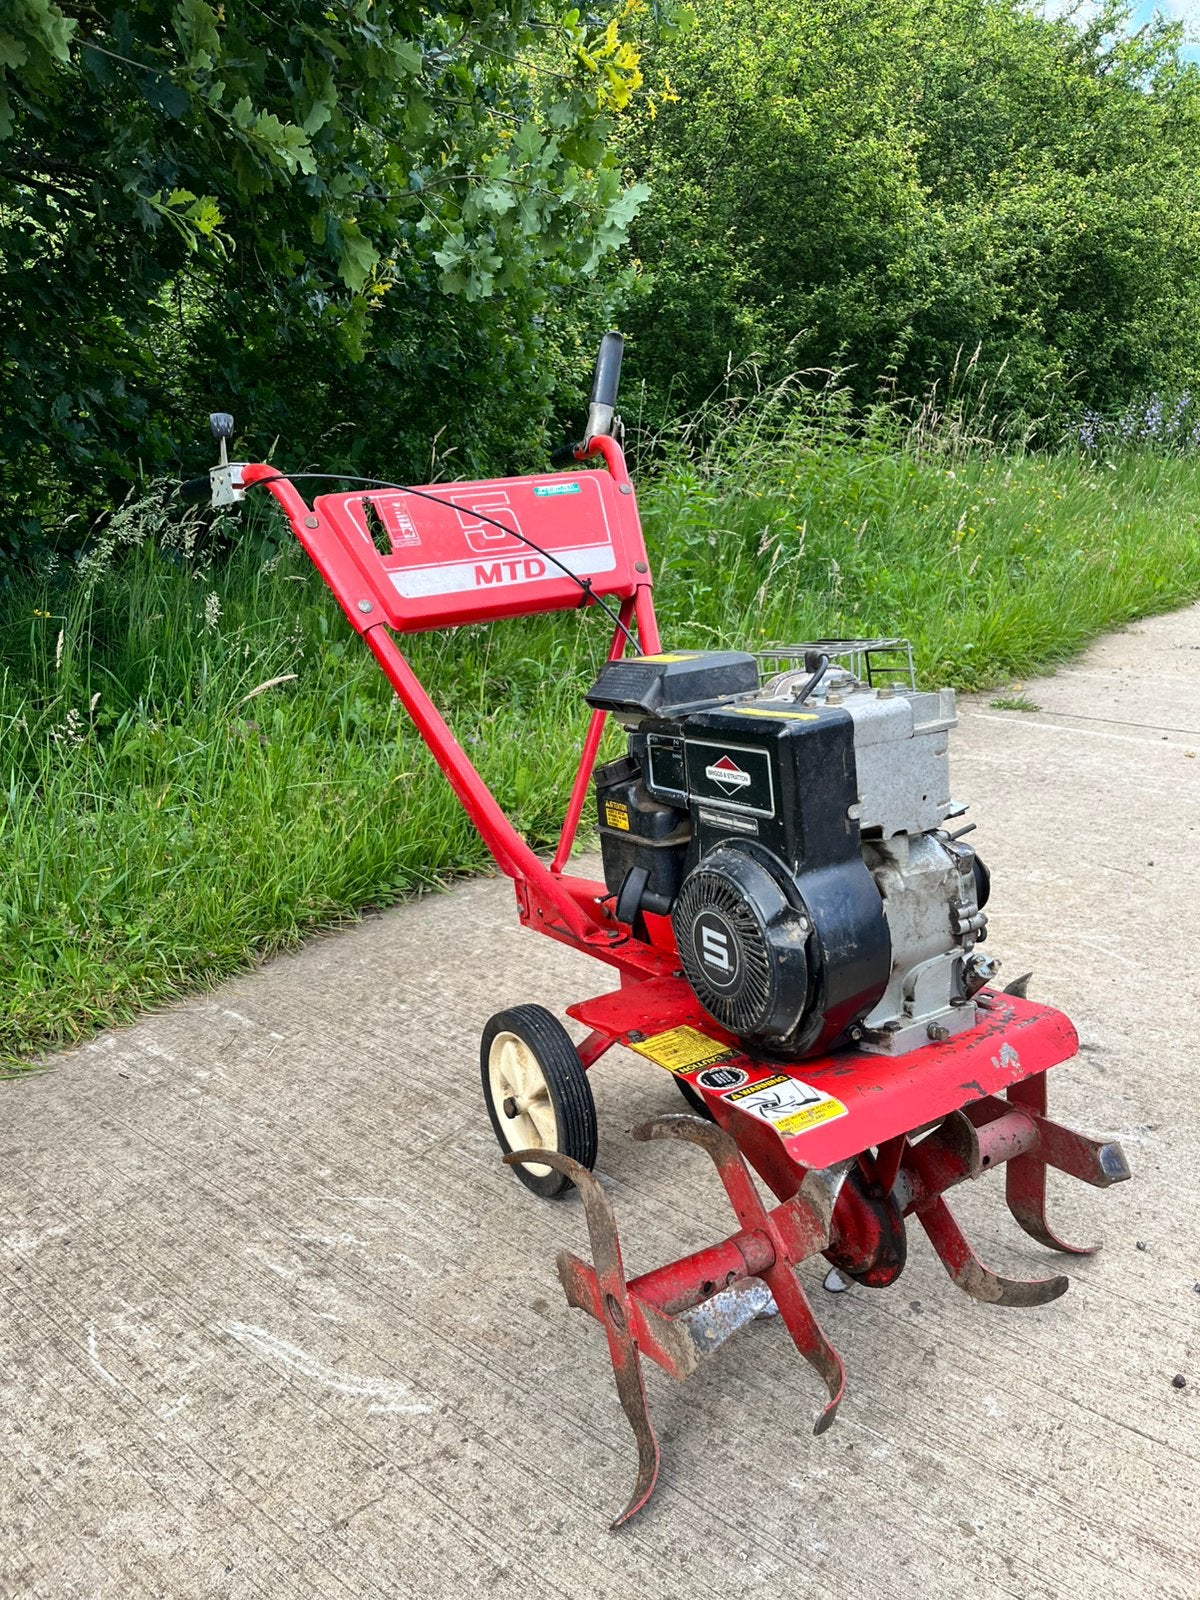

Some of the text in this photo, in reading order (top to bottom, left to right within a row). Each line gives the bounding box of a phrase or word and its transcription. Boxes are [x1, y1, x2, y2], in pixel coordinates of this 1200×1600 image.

[450, 491, 527, 553] 5
[474, 557, 547, 586] MTD
[707, 769, 723, 778] BRIGGS
[727, 772, 749, 782] STRATTON
[679, 1055, 723, 1074] CAUTION
[739, 1075, 788, 1095] WARNING
